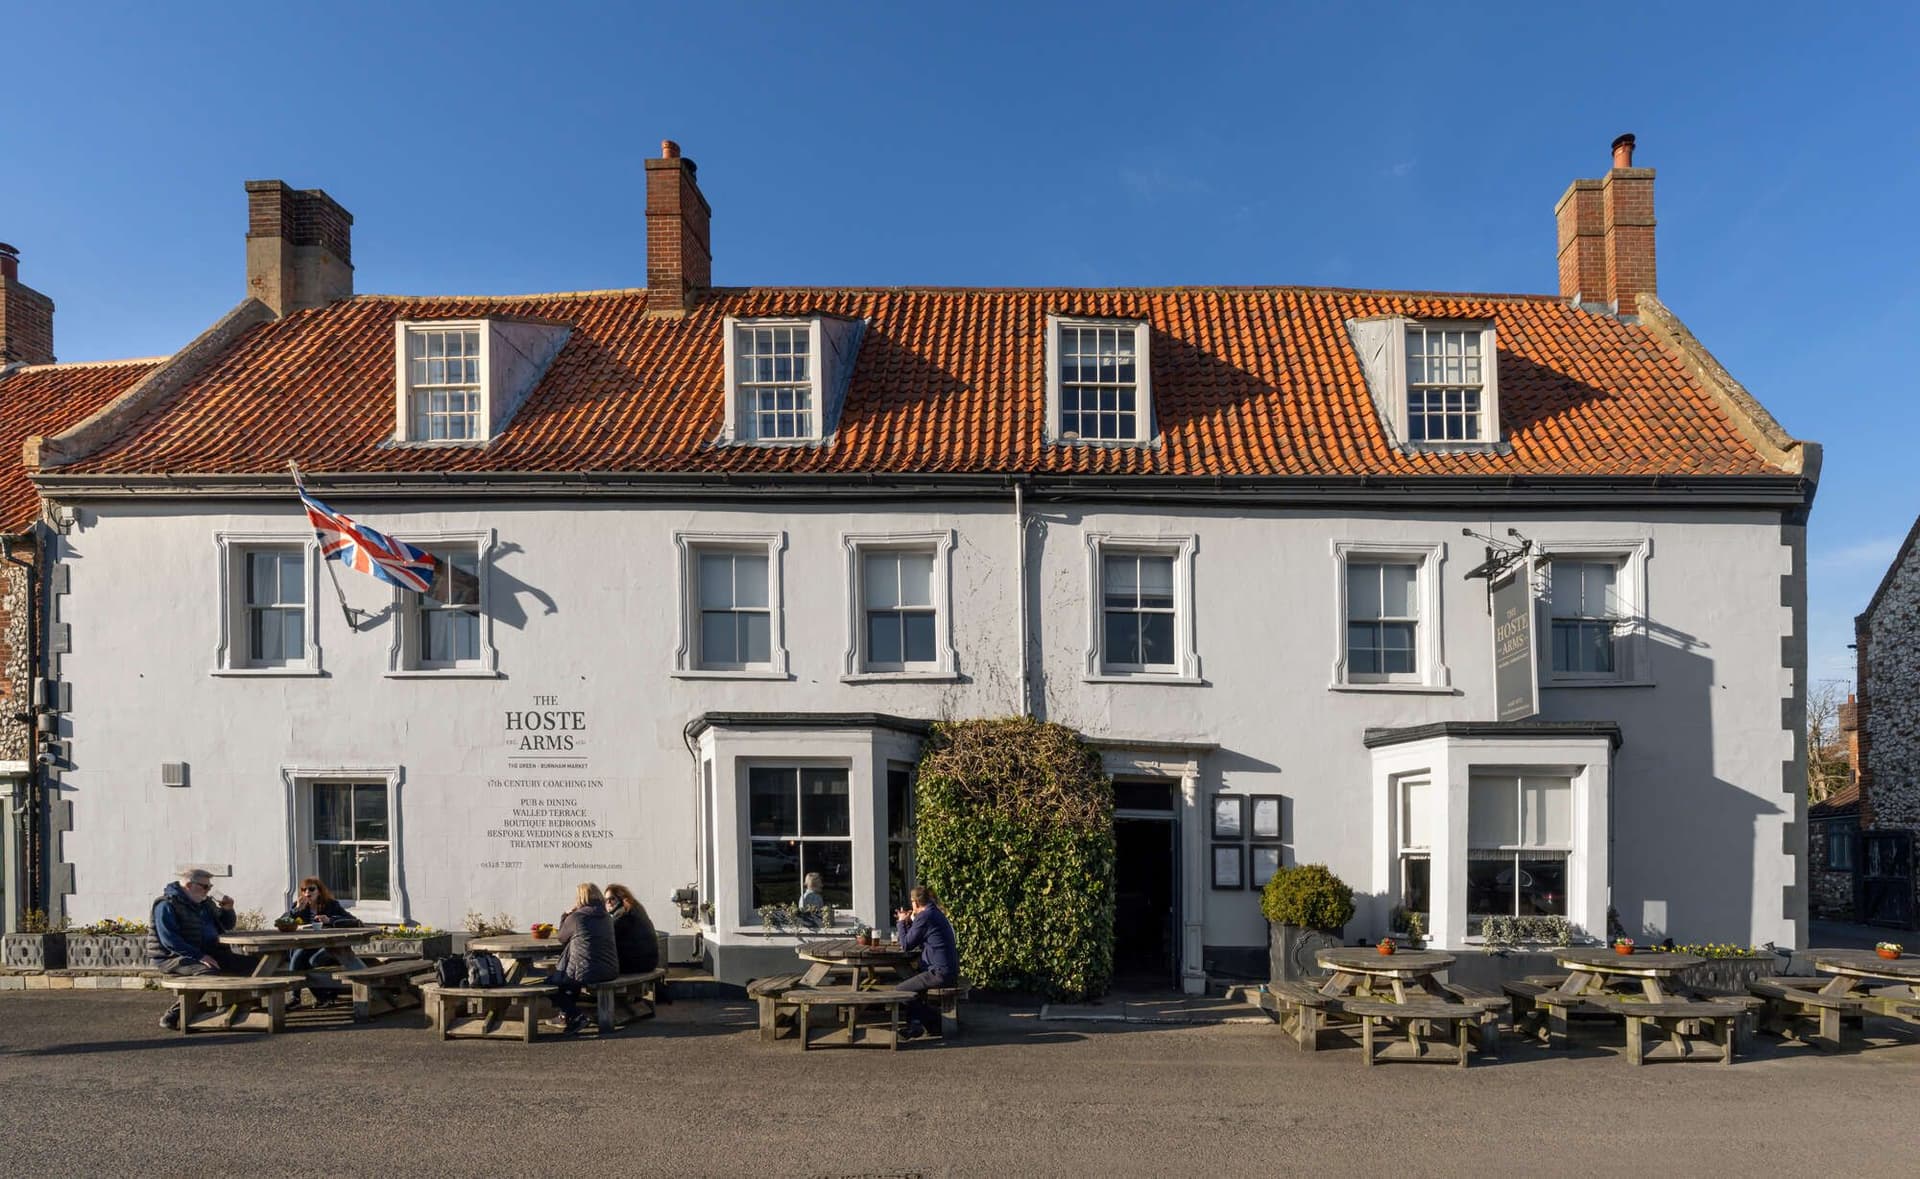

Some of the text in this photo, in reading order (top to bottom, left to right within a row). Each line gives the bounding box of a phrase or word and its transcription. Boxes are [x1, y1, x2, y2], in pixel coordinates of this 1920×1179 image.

[1496, 613, 1529, 642] HOSTE
[1501, 635, 1525, 656] ARMS
[533, 695, 559, 706] THE
[505, 711, 586, 731] HOSTE
[518, 735, 574, 751] ARMS
[504, 780, 541, 788] CENTURY
[543, 780, 587, 788] COACHING
[588, 780, 604, 788] INN
[520, 798, 538, 807] PUB
[546, 798, 578, 807] DINING
[512, 809, 587, 817] WALLED TERRACE
[504, 819, 597, 828] BOUTIQUE BEDROOMS
[487, 830, 526, 838] BESPOKE
[527, 830, 573, 838] WEDDINGS
[582, 830, 615, 838] EVENTS
[510, 840, 593, 849] TREATMENT ROOMS
